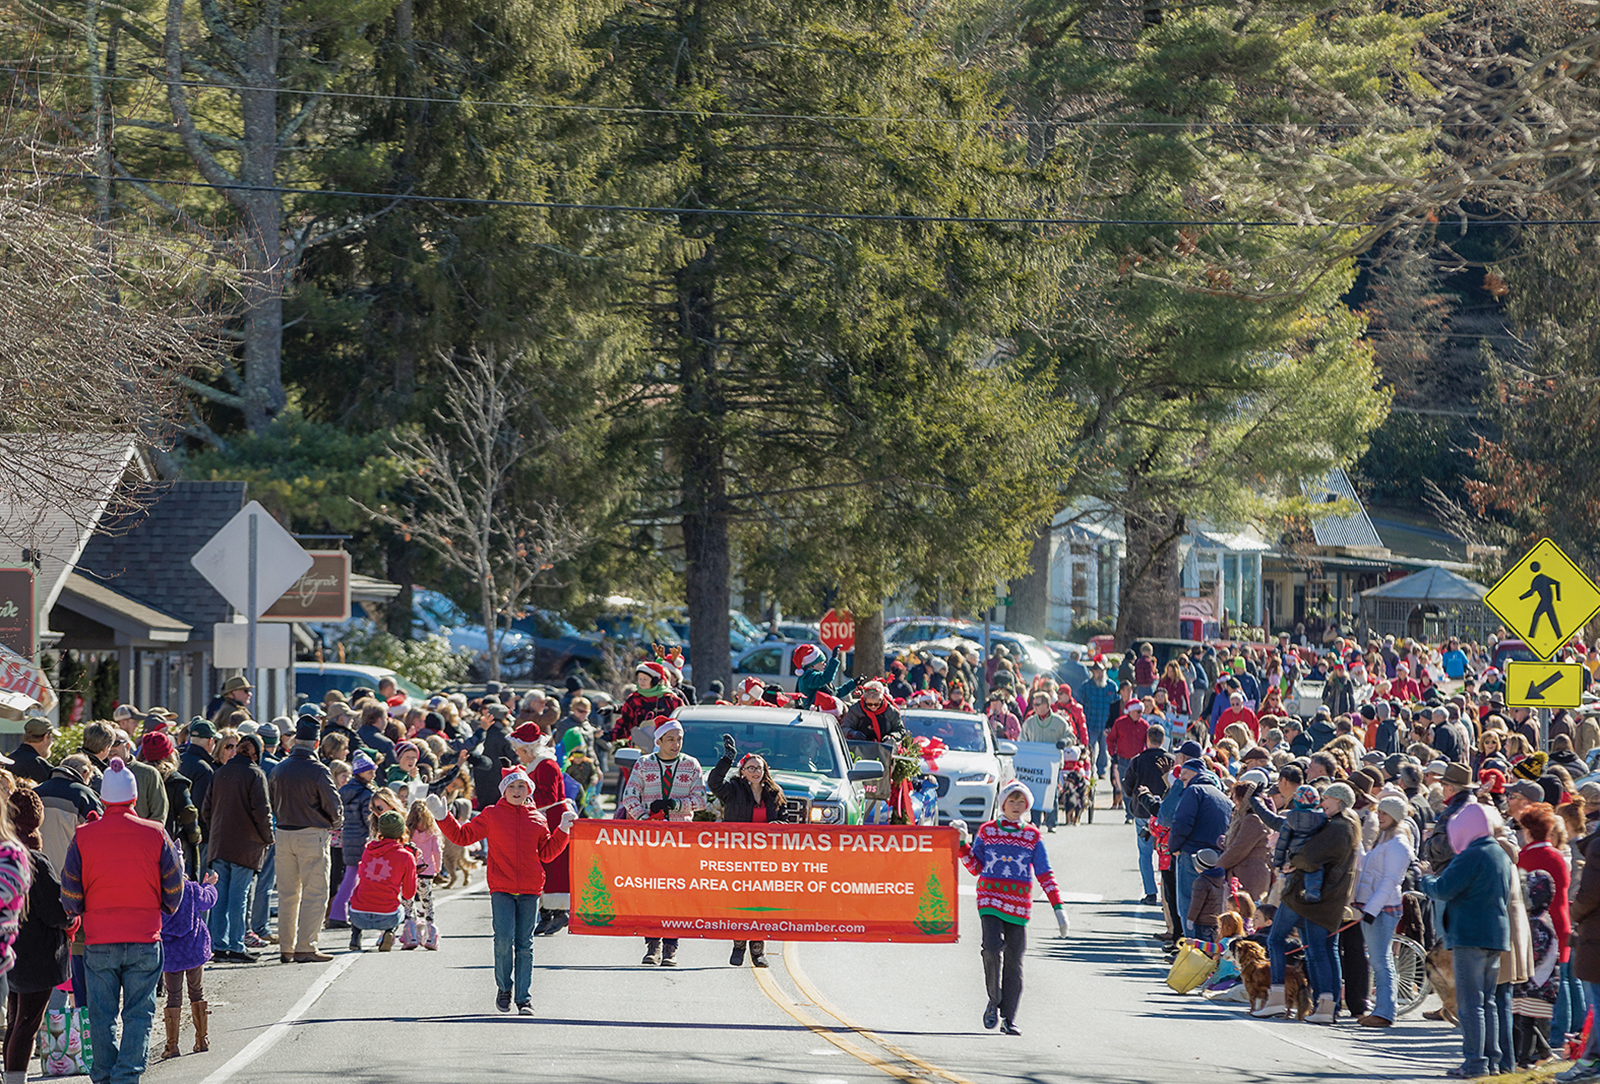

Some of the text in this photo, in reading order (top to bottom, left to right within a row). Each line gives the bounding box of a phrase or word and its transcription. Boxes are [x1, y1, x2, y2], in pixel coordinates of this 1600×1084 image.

[822, 621, 855, 640] STOP
[1018, 774, 1034, 783] DOG
[595, 828, 933, 853] ANNUAL CHRISTMAS PARADE
[700, 860, 829, 874] PRESENTED BY THE
[614, 875, 915, 895] CASHIERS AREA CHAMBER OF COMMERCE
[661, 918, 866, 934] www.CashiersAreaChamber.com
